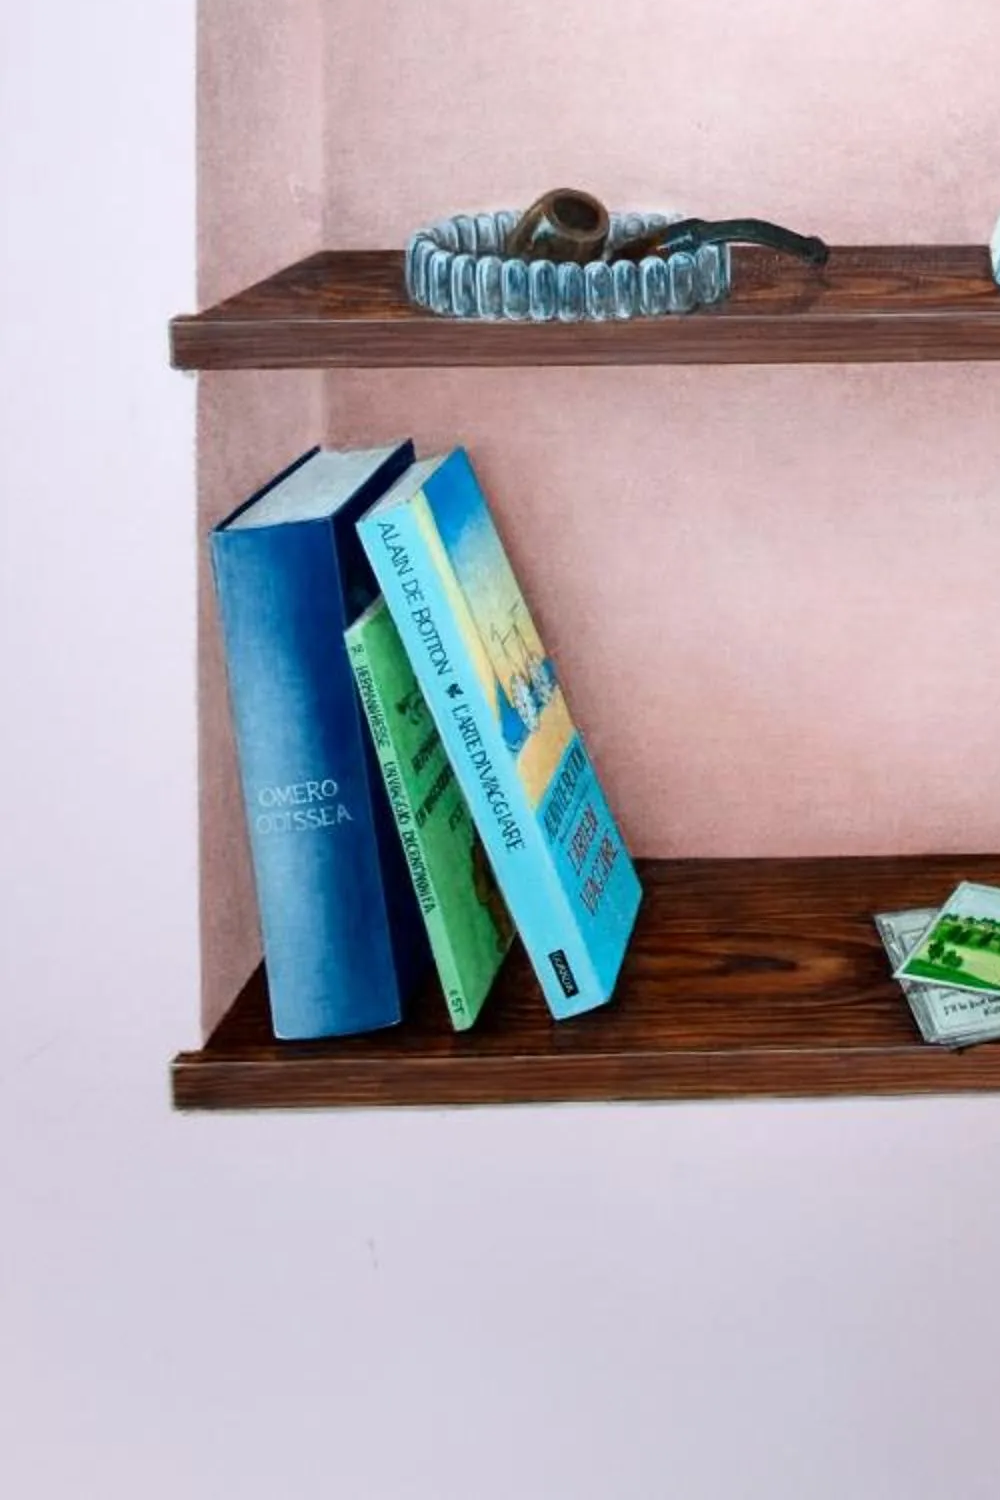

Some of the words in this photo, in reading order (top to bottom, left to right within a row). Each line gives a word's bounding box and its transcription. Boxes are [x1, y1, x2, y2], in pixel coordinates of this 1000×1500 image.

[376, 522, 414, 577] ALAIN
[400, 578, 424, 605] DE
[410, 606, 453, 676] BOTTON
[258, 780, 339, 806] OMERO
[254, 803, 355, 834] ODISSEA
